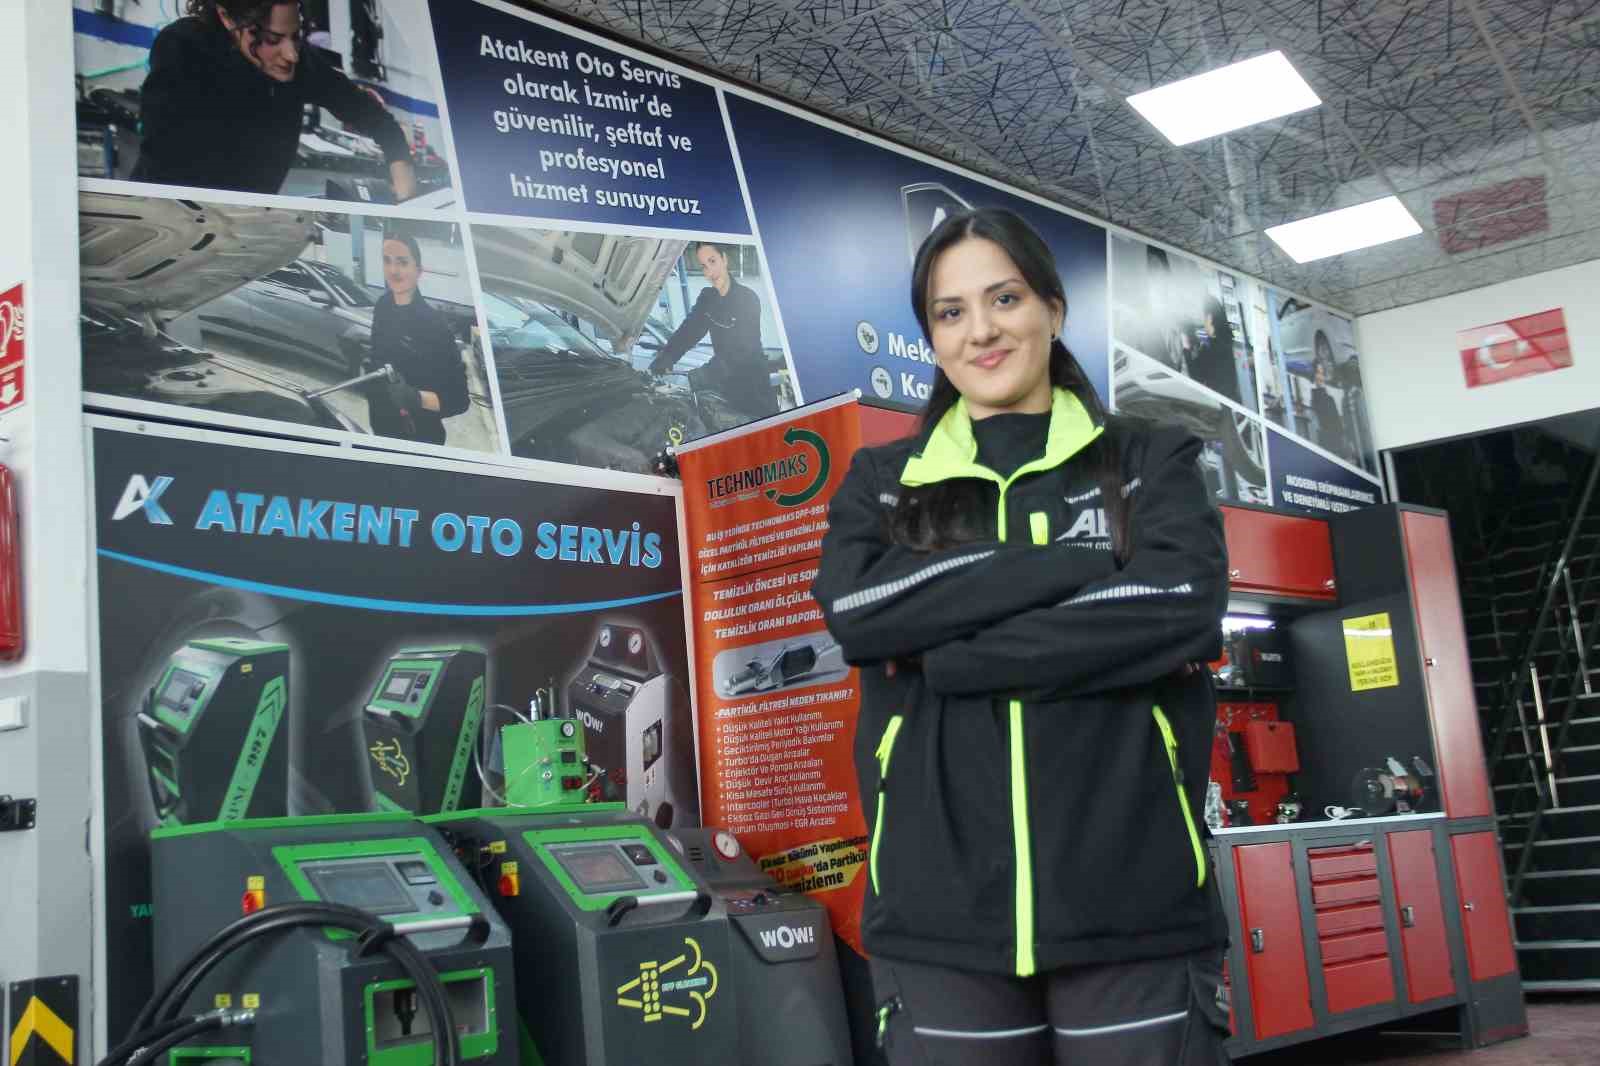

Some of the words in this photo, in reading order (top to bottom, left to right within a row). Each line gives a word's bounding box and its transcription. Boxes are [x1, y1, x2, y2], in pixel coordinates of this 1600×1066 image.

[480, 35, 568, 70] Atakent
[576, 52, 614, 78] Oto
[622, 59, 681, 89] Servis
[503, 73, 579, 105] olarak
[584, 79, 672, 118] İzmir'de
[493, 106, 600, 143] güvenilir,
[605, 123, 662, 147] şeffaf
[668, 134, 692, 152] ve
[539, 147, 665, 179] profesyonel
[509, 173, 589, 203] hizmet
[595, 189, 702, 215] sunuyoruz
[707, 454, 808, 499] TECHNOMAKS
[195, 490, 419, 547] ATAKENT
[432, 512, 523, 557] OTO
[535, 521, 662, 569] SERVİS
[713, 582, 753, 601] TEMİZLİK
[755, 573, 786, 592] ÖNCESİ
[787, 572, 799, 585] VE
[703, 605, 747, 622] DOLULUK
[748, 599, 774, 614] ORANI
[714, 620, 757, 639] TEMİZLİK
[758, 616, 785, 631] ORANI
[576, 709, 603, 732] WOW!
[760, 926, 814, 948] WOW!
